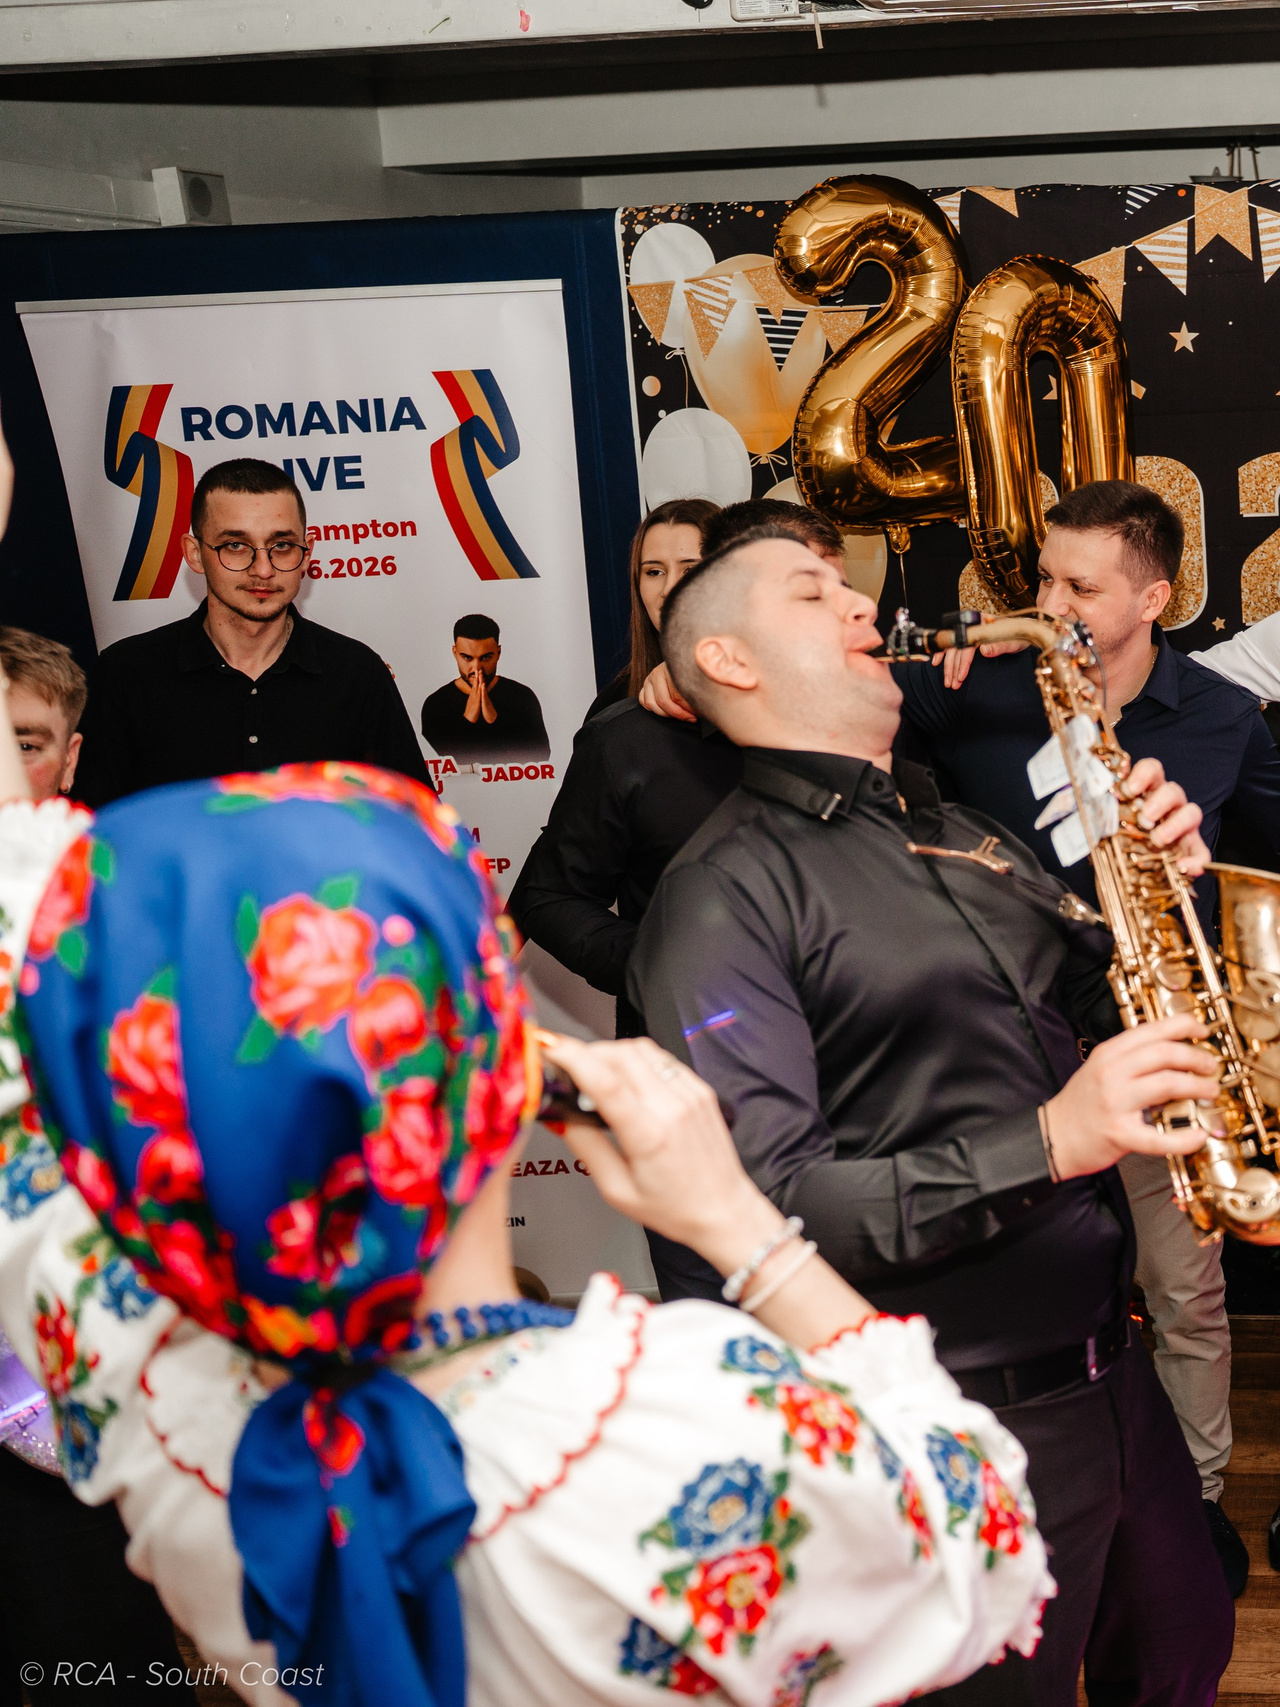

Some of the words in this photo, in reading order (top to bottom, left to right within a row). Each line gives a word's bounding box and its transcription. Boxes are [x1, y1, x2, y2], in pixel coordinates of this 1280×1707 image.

[180, 396, 427, 442] ROMANIA
[282, 455, 365, 492] IVE
[301, 555, 398, 580] 6.2026
[481, 764, 555, 783] JADOR
[483, 857, 511, 874] FP
[511, 1159, 570, 1178] EAZA
